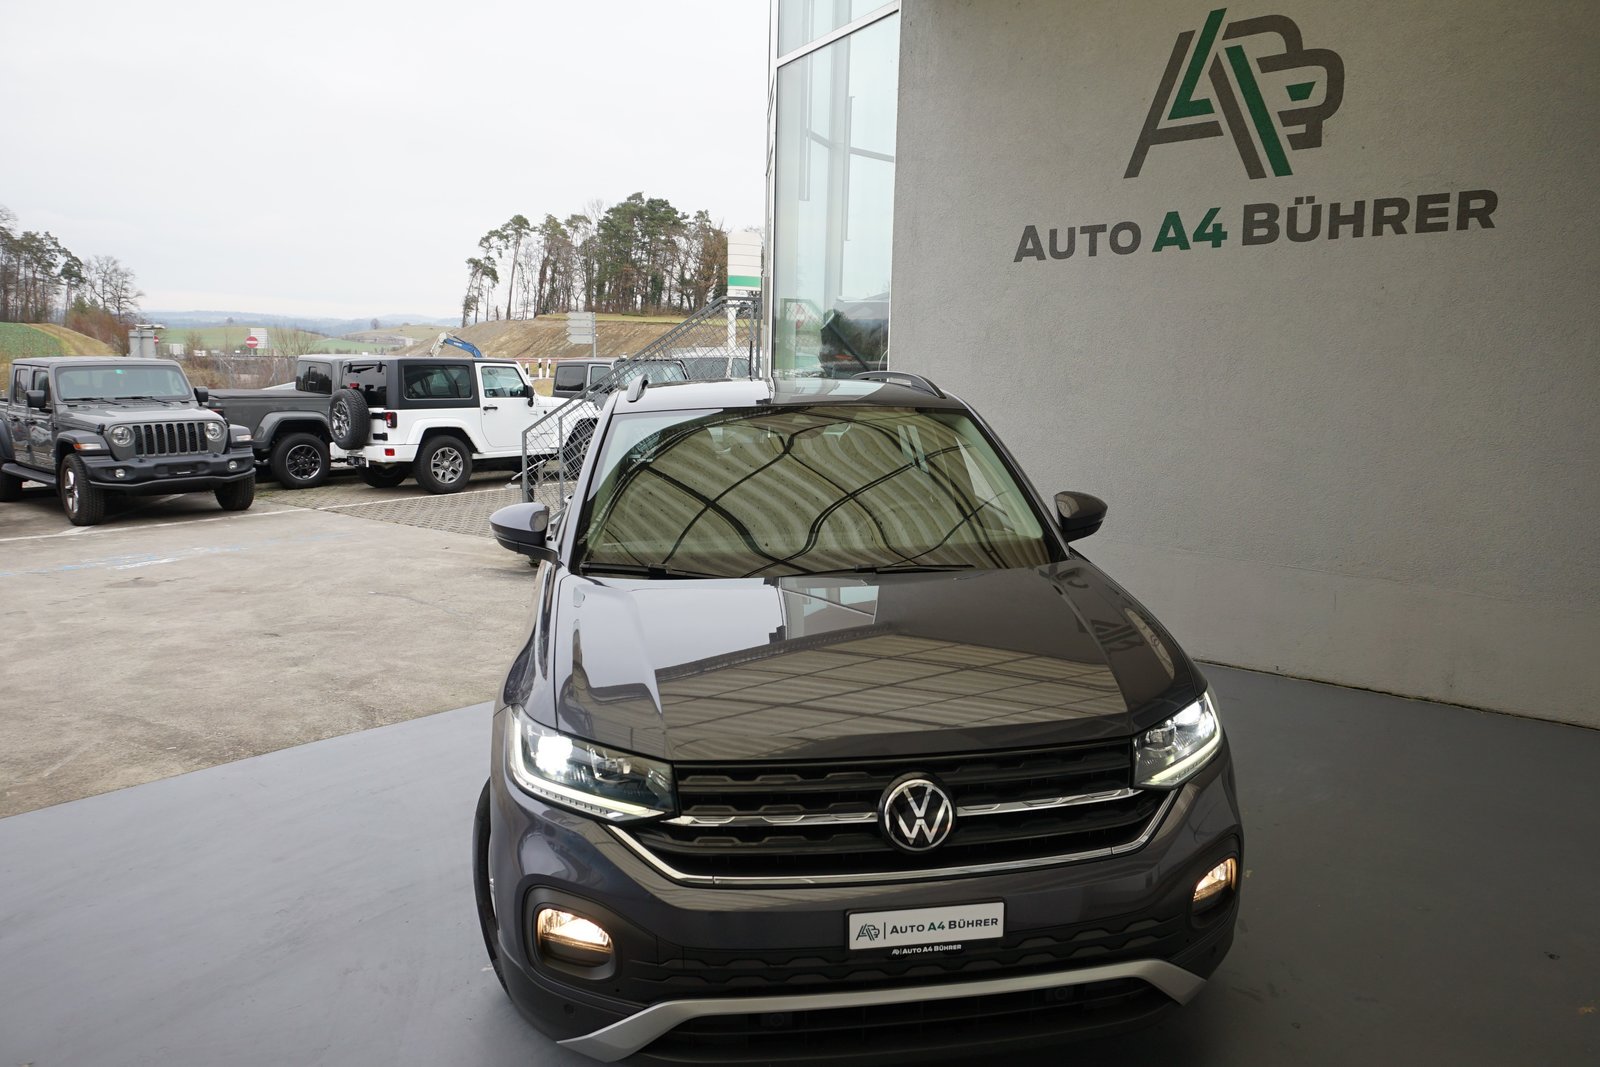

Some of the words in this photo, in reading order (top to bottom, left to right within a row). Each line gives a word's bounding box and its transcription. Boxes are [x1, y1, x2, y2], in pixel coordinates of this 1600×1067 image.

[1013, 220, 1142, 263] AUTO
[1151, 206, 1228, 253] A4
[1241, 188, 1499, 247] BÜHRER
[889, 924, 925, 935] AUTO
[927, 921, 946, 932] A4
[948, 917, 999, 930] BÜHRER
[902, 947, 922, 955] AUTO
[933, 944, 962, 952] BÜHRER
